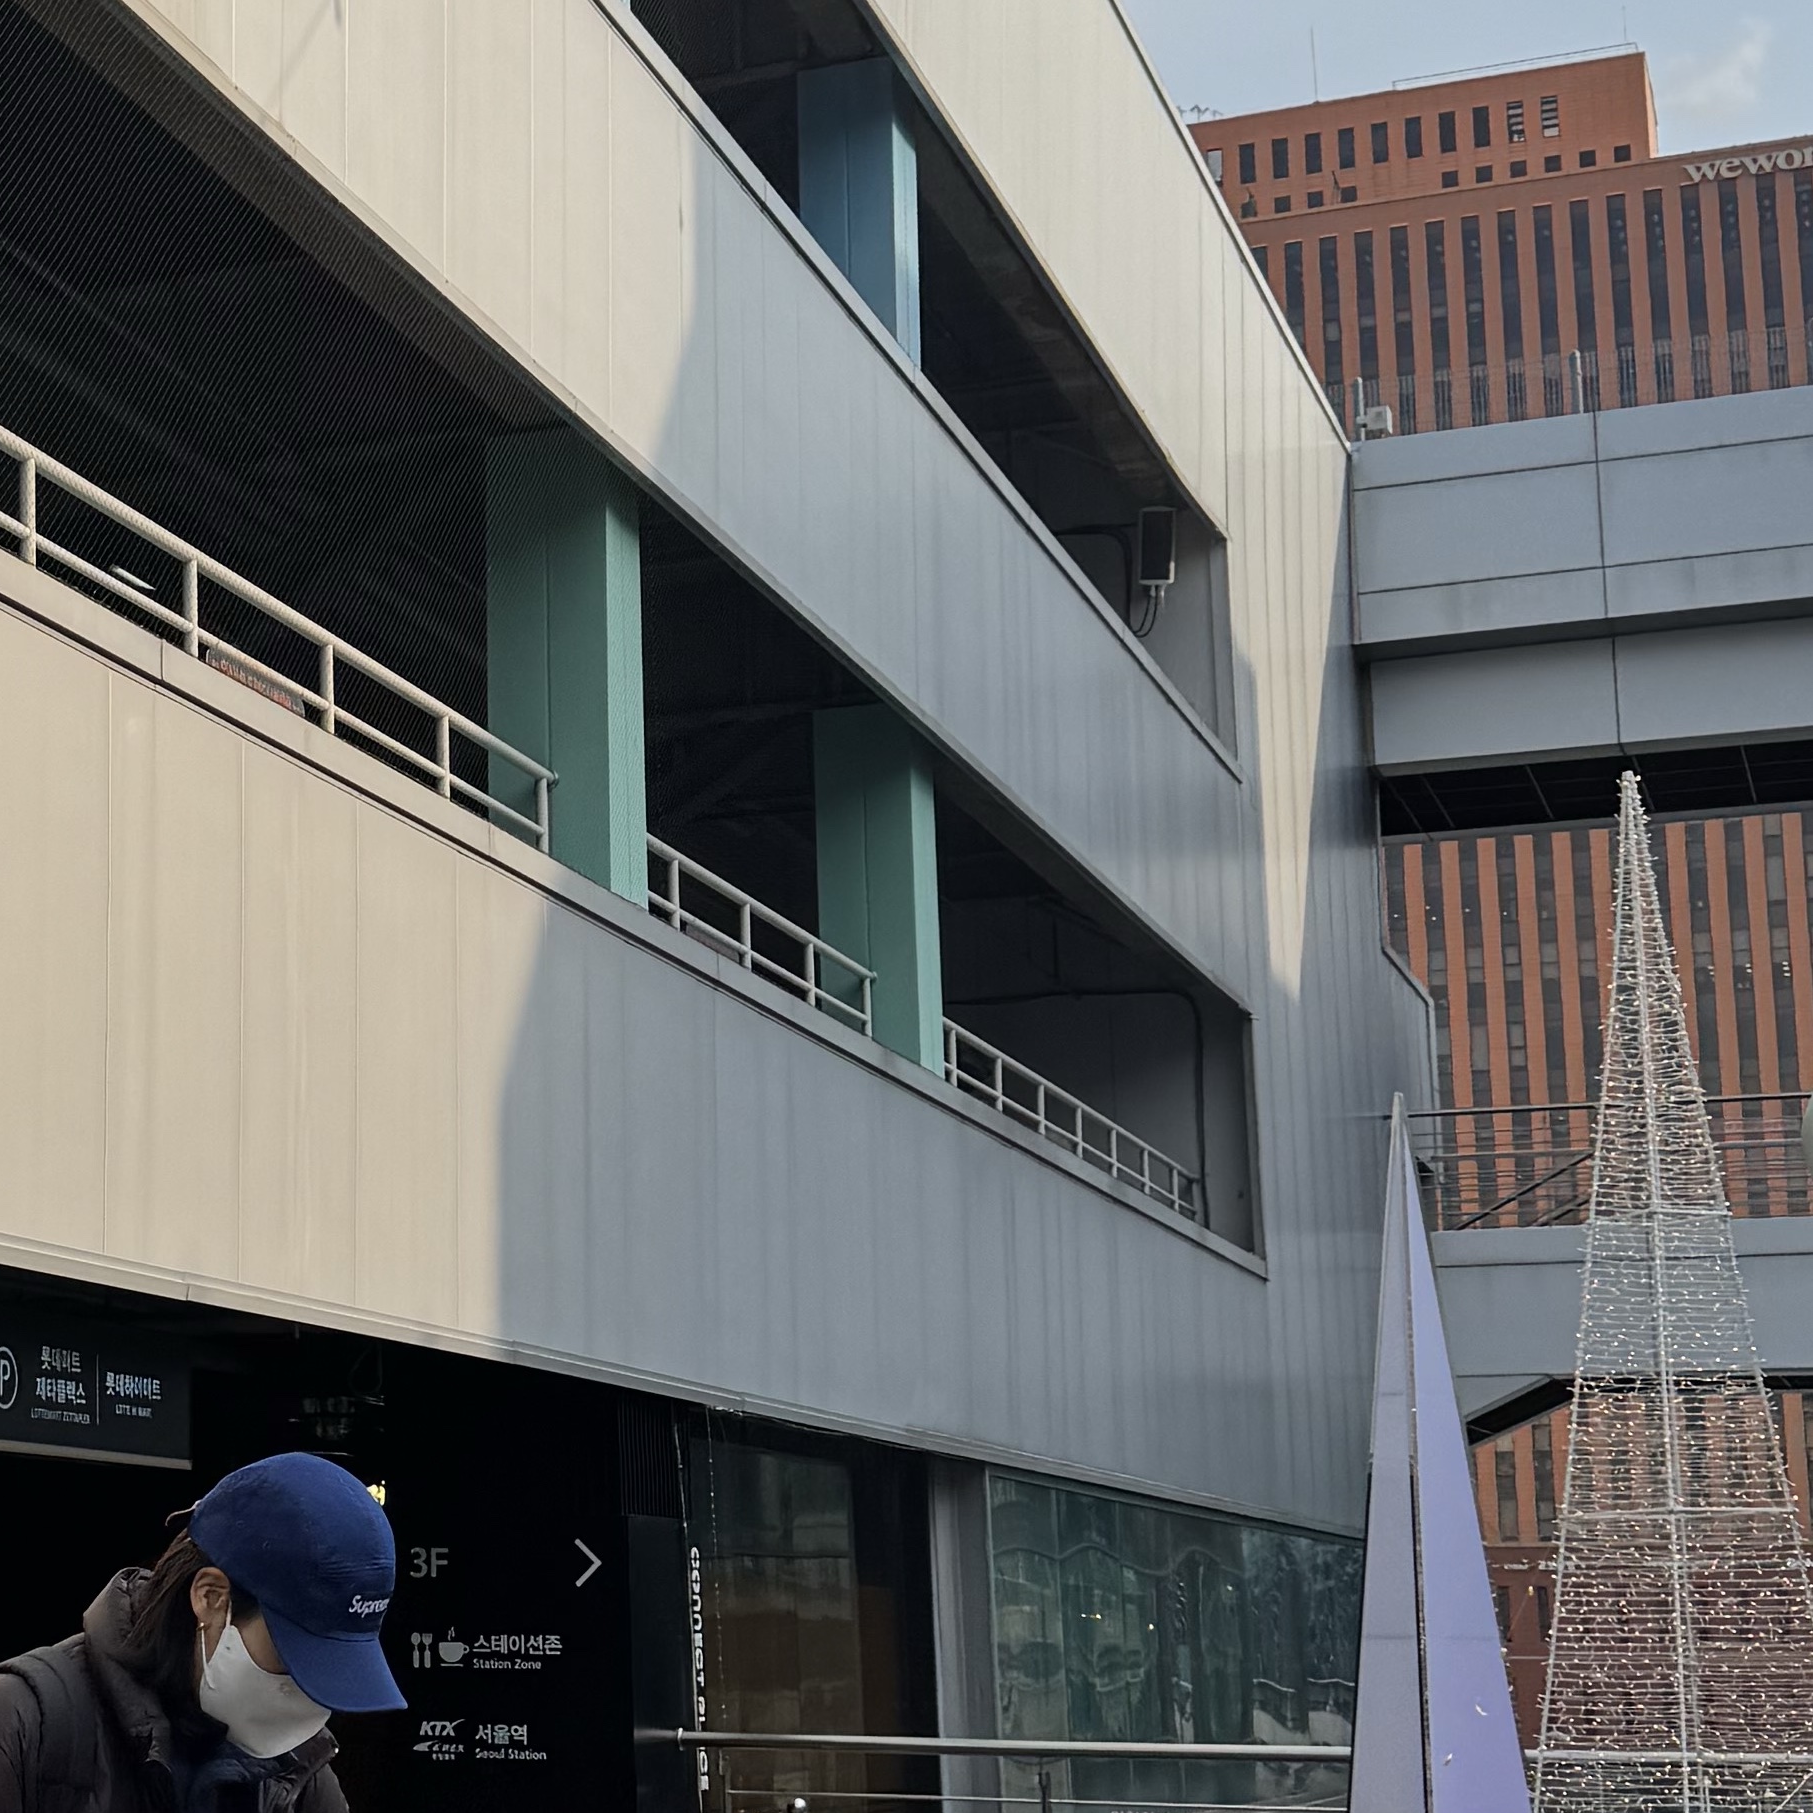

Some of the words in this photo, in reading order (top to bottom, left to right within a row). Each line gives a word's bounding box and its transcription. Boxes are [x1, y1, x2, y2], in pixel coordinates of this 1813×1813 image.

[409, 1547, 449, 1578] 3F
[472, 1633, 563, 1656] 스테이션존
[472, 1657, 512, 1670] Station
[513, 1657, 542, 1670] Zone
[419, 1718, 466, 1737] KTX
[474, 1723, 528, 1746] 서울역
[507, 1747, 548, 1761] Station
